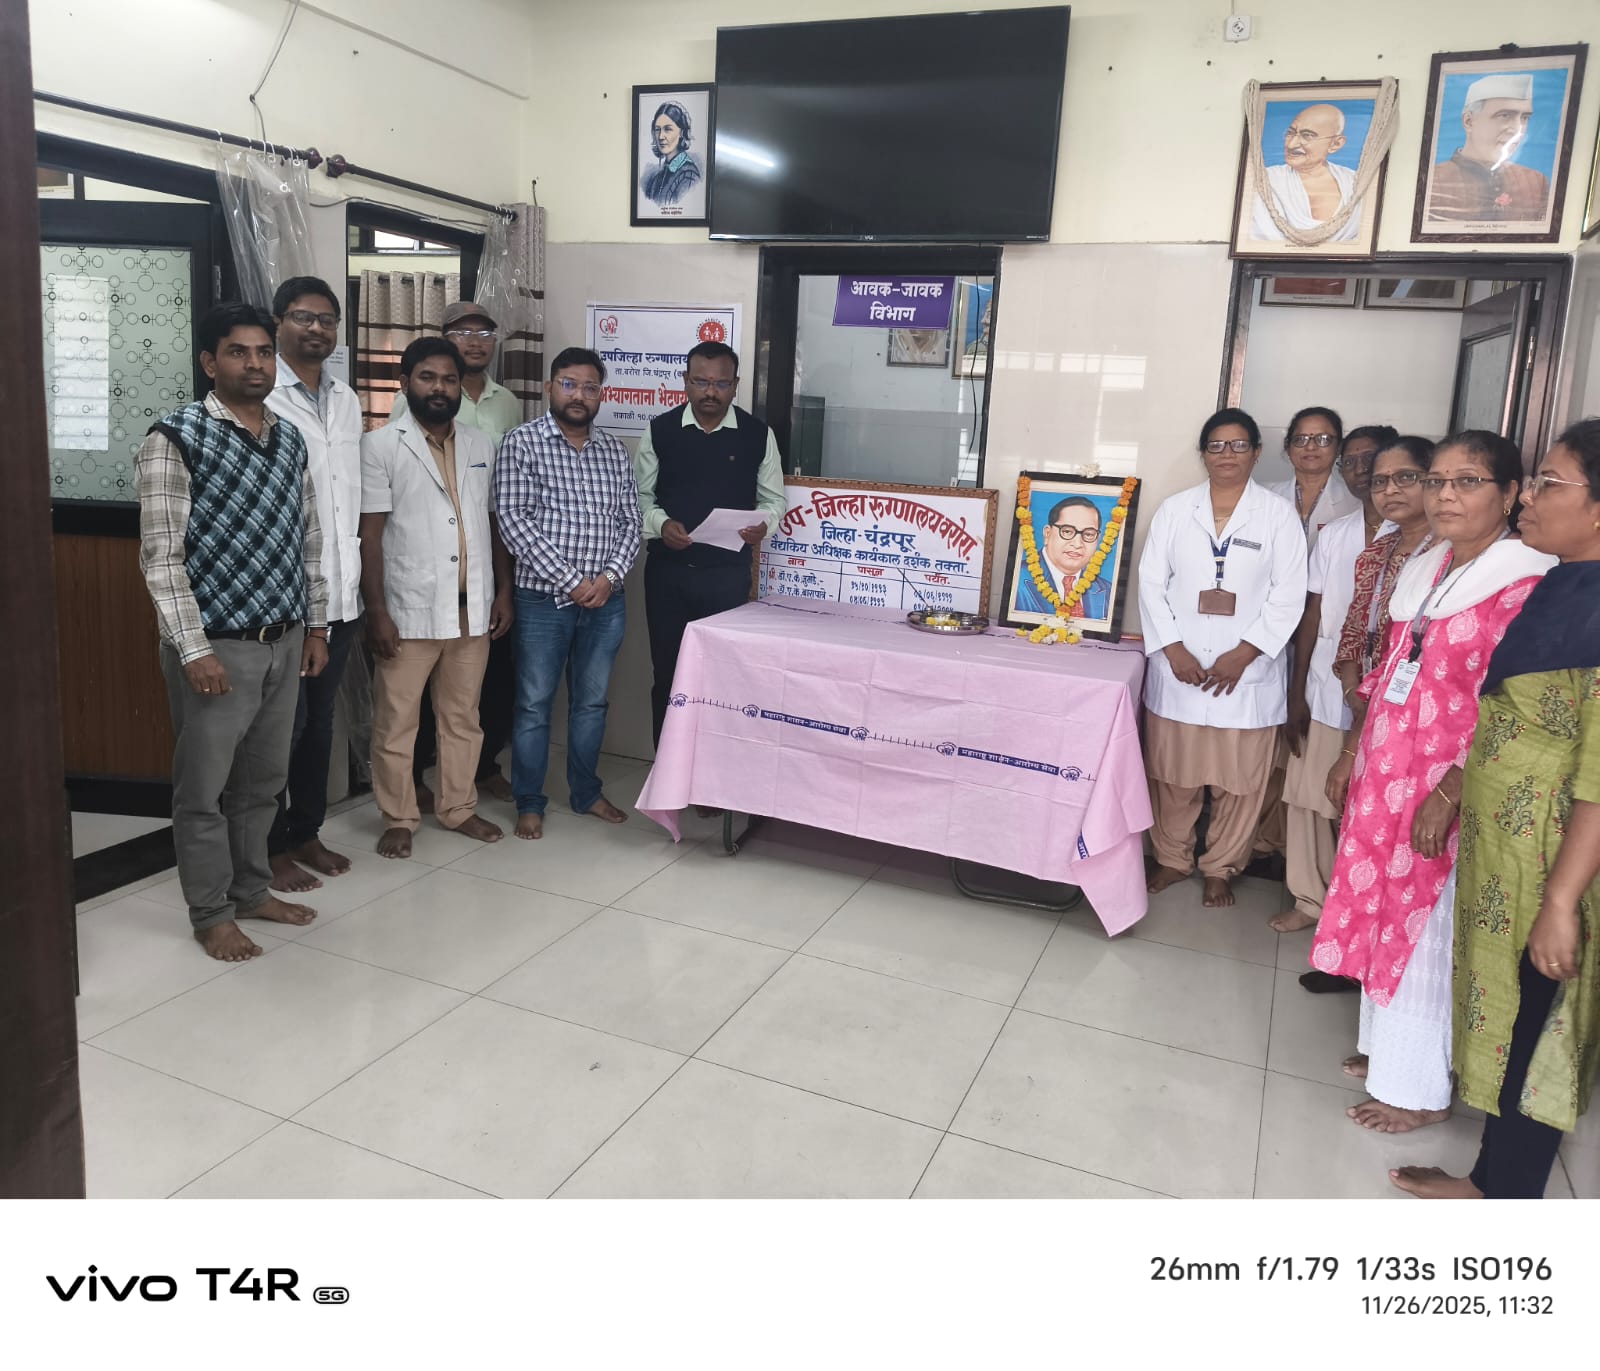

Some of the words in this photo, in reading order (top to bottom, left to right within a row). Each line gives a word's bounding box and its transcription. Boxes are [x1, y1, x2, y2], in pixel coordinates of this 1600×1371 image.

[850, 280, 944, 298] आवक-जावक
[869, 301, 917, 322] विभाग
[600, 347, 643, 365] उपजिल्हा
[787, 557, 807, 567] नाव
